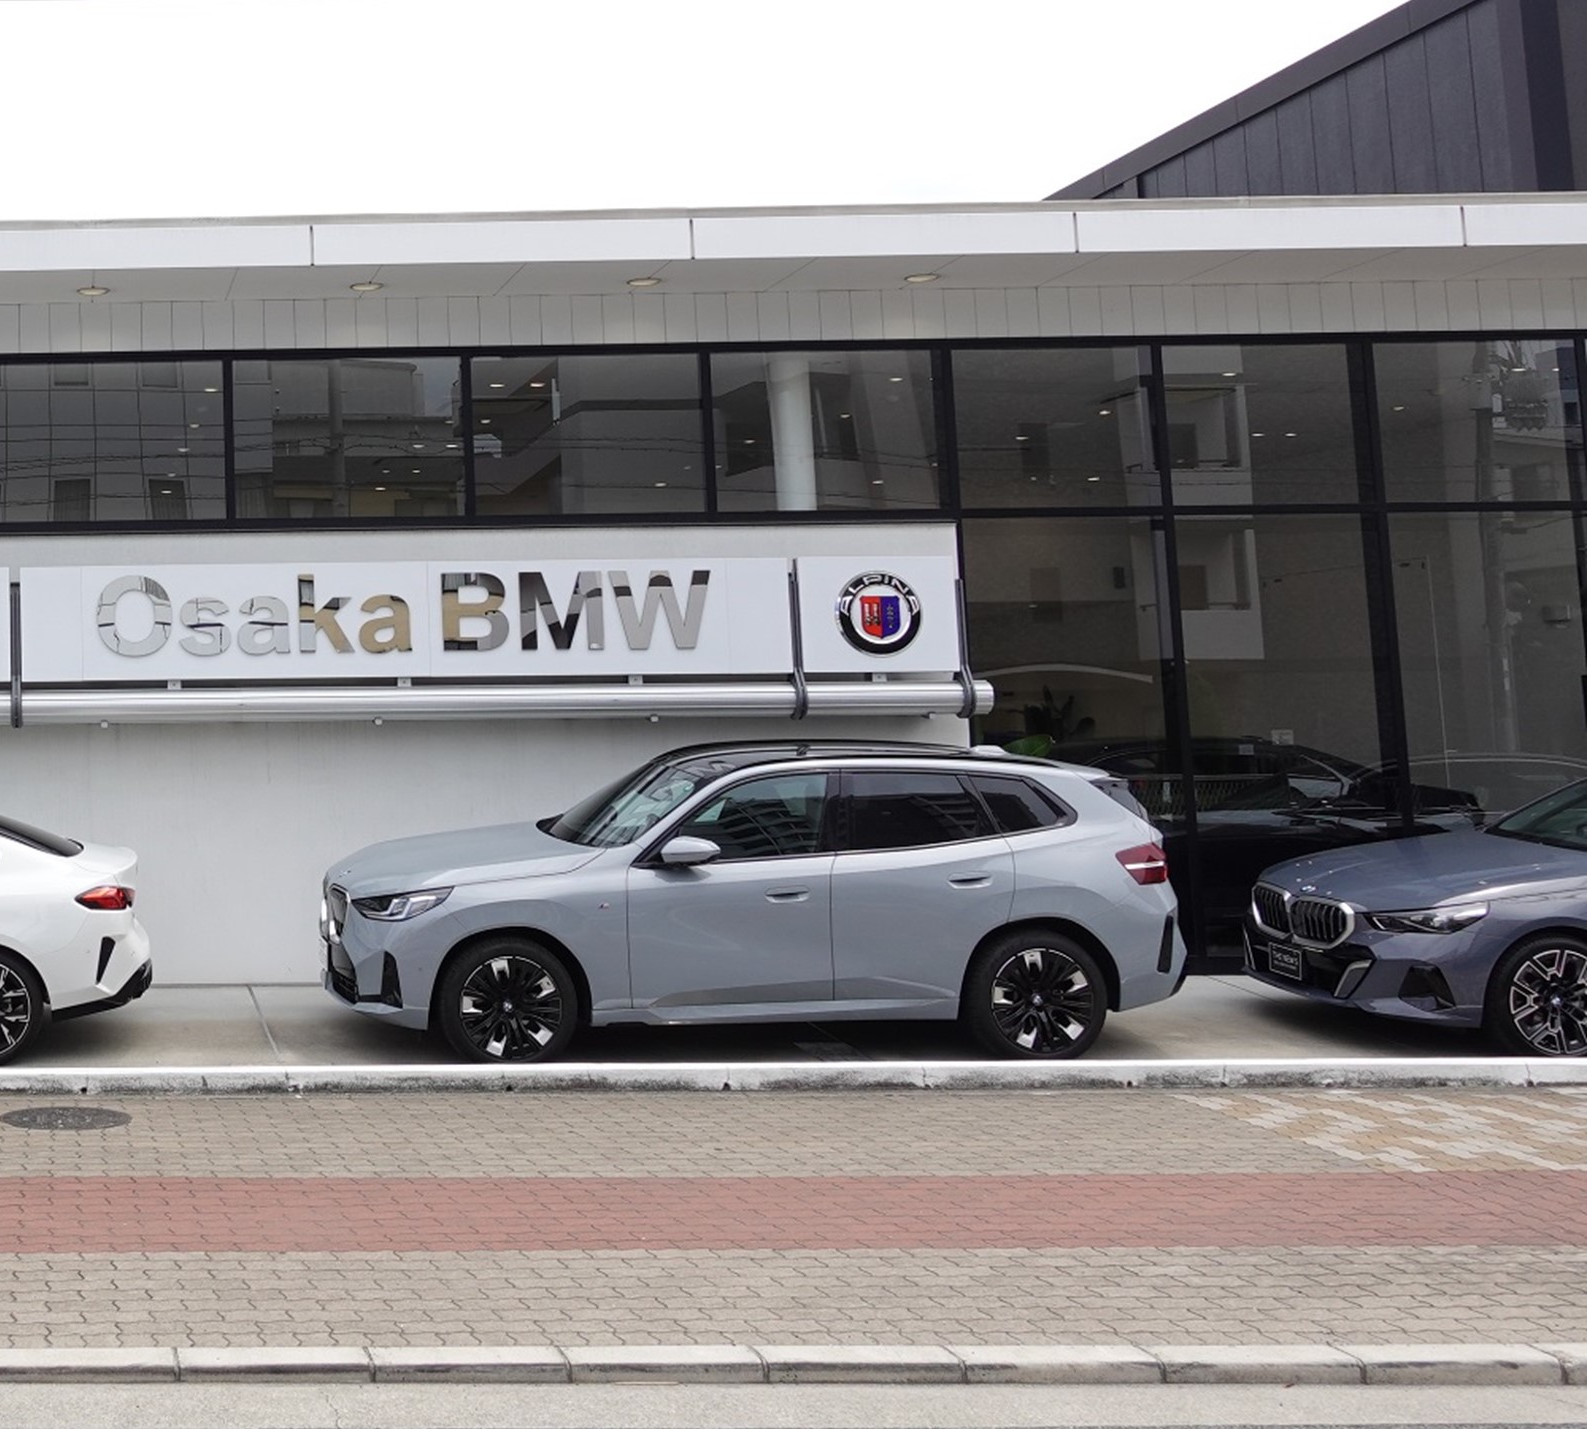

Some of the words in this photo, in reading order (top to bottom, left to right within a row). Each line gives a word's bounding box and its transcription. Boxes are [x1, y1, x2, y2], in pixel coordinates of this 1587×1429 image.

[96, 574, 412, 657] Osaka
[440, 570, 711, 651] BMW
[840, 574, 920, 616] ALPINA
